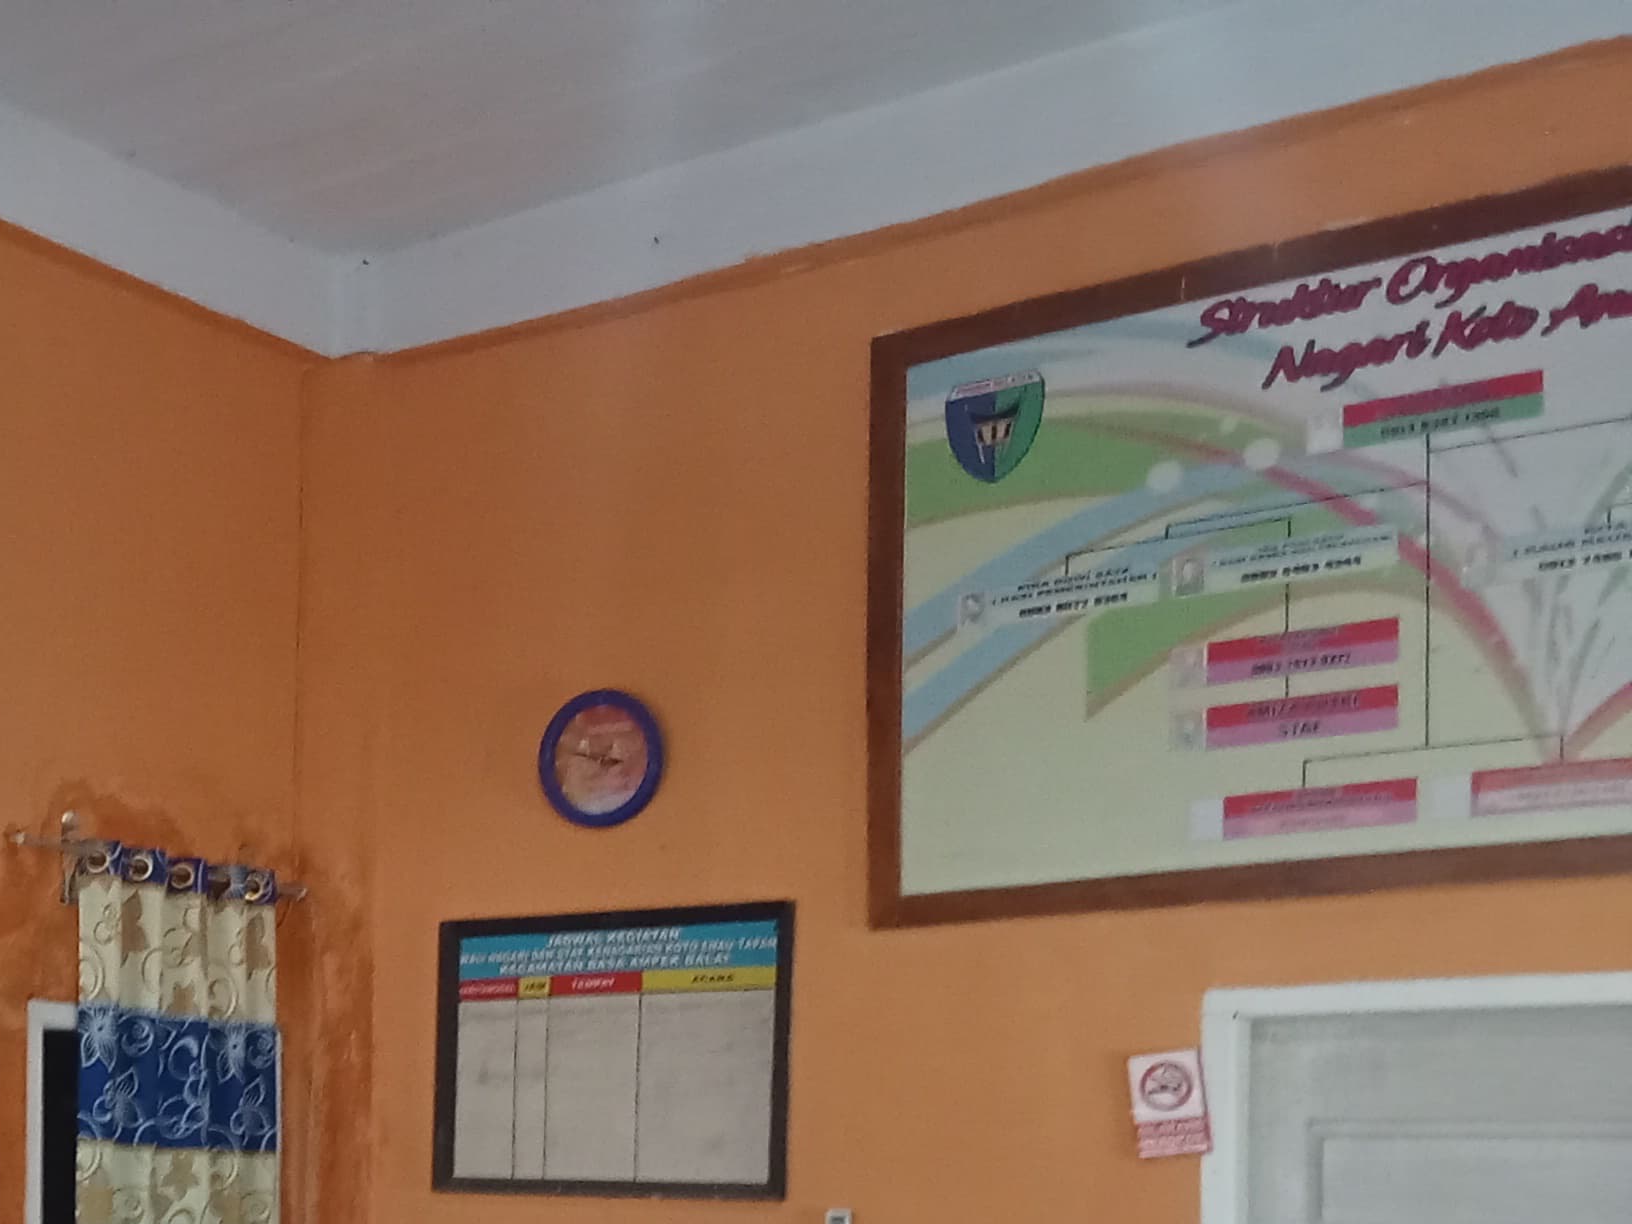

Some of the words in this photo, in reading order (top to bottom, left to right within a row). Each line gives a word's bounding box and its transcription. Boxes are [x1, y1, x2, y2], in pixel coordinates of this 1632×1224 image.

[1186, 277, 1382, 348] Struktur
[1386, 222, 1632, 309] Organisas
[1261, 320, 1432, 391] Nagari
[1432, 301, 1539, 358] Koto
[606, 927, 681, 944] KEGIATAN
[499, 961, 584, 976] KECAMATAN
